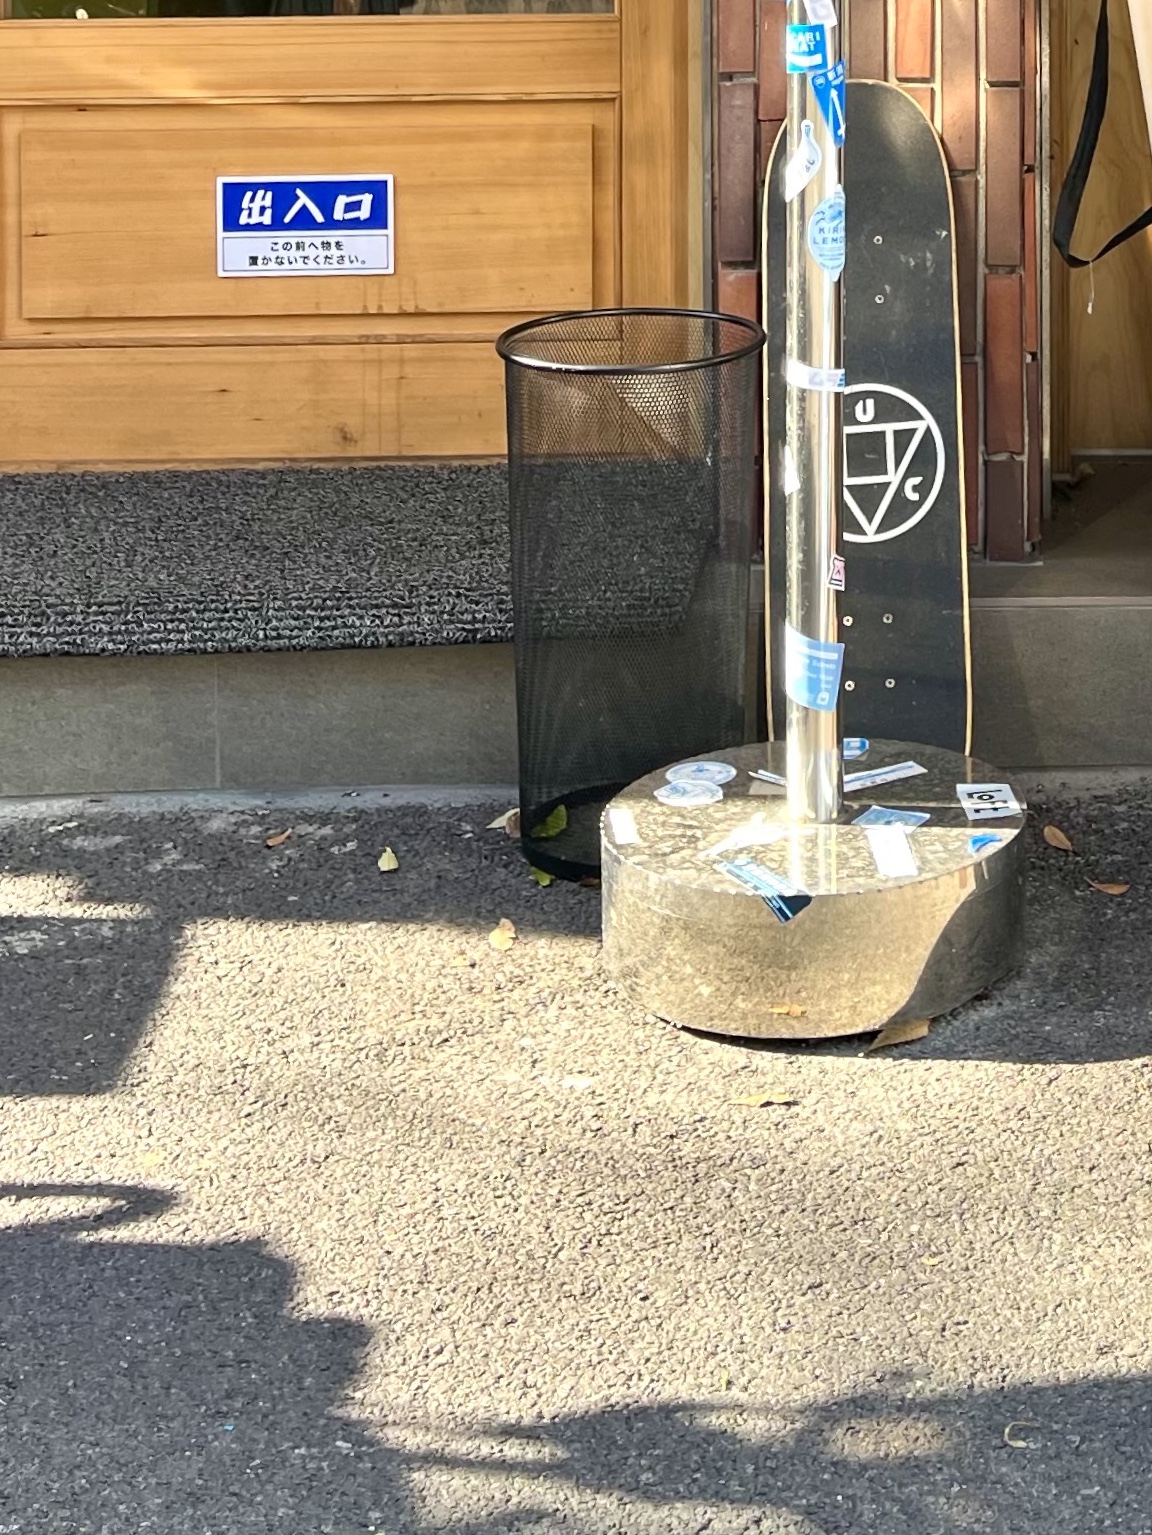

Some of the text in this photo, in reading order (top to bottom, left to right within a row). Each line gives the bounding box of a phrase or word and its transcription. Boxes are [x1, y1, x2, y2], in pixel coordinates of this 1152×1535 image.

[238, 187, 374, 226] 出入口
[269, 240, 345, 252] この前へ物を
